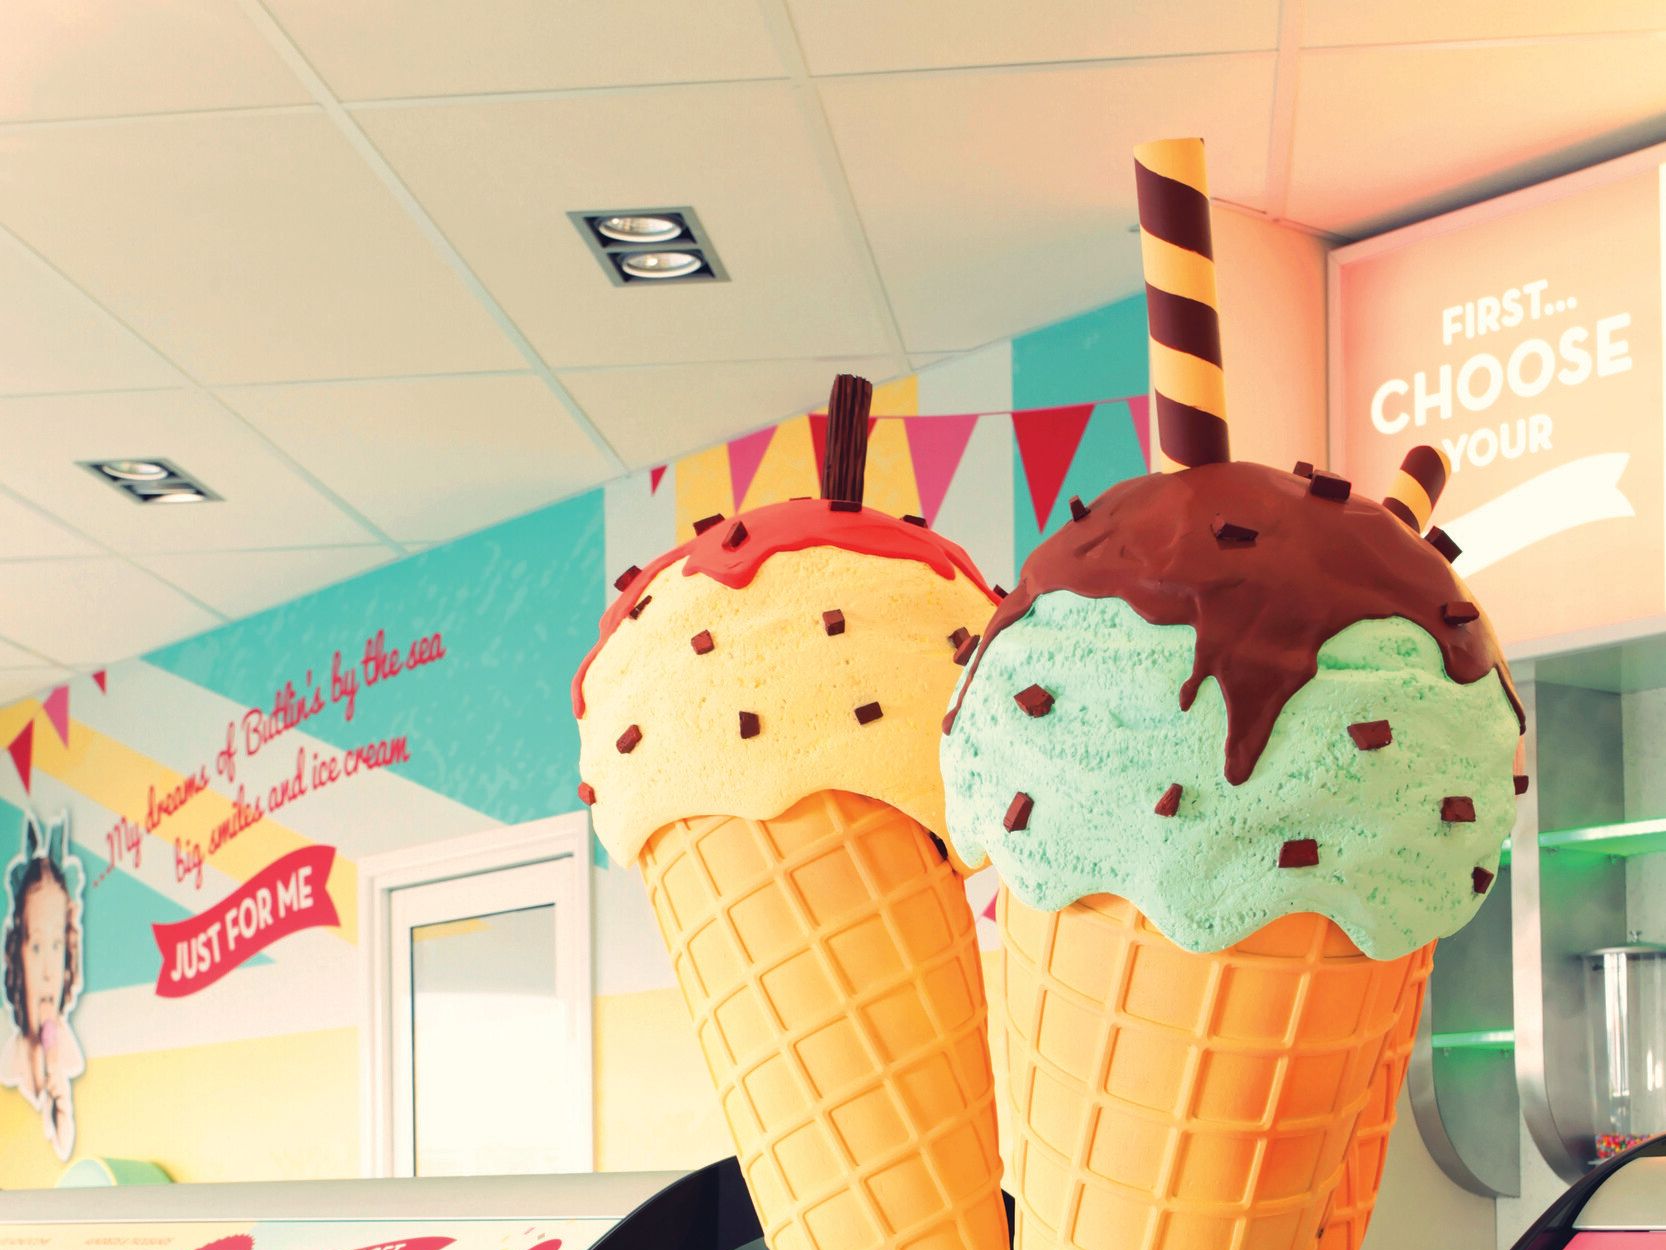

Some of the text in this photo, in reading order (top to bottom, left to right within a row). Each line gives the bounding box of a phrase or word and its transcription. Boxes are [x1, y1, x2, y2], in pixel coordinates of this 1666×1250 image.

[1442, 278, 1578, 346] FIRST...
[1370, 312, 1633, 435] CHOOSE
[1441, 413, 1553, 473] YOUR
[146, 764, 209, 834] dreams
[217, 721, 236, 783] of
[242, 669, 325, 757] Butlin's
[331, 650, 359, 722] by
[361, 628, 403, 687] the
[406, 632, 447, 670] sea
[175, 736, 412, 890] big smiles and ice cream
[171, 865, 314, 982] JUST FOR ME
